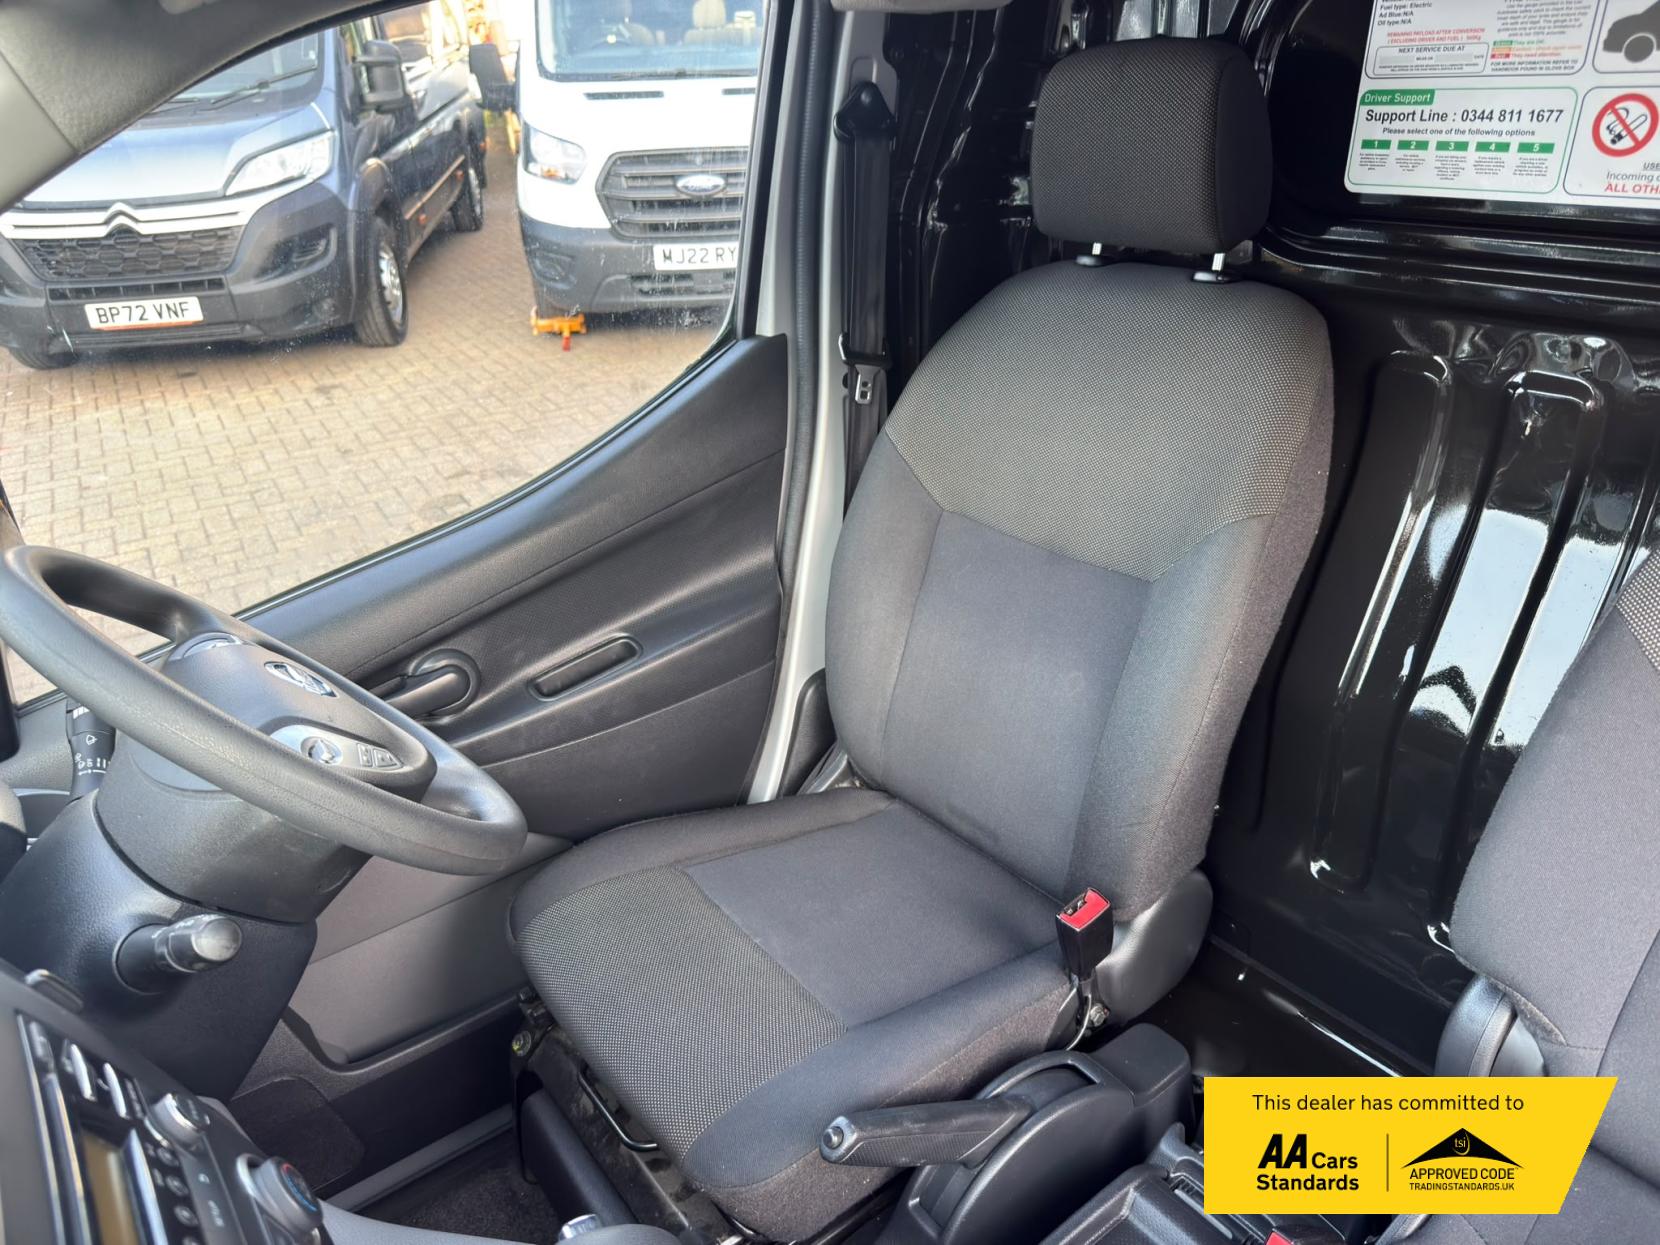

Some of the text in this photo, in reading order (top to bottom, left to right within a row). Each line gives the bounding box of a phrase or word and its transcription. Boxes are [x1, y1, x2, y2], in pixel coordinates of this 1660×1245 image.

[1364, 93, 1430, 104] Driver Support
[1365, 109, 1416, 124] Support
[1419, 109, 1448, 122] Line
[1461, 109, 1494, 122] 0344
[1498, 109, 1522, 122] 811
[1529, 109, 1564, 123] 1677
[1407, 127, 1428, 135] select
[1468, 128, 1503, 137] following
[1410, 141, 1416, 149] 2
[1448, 142, 1455, 150] 3
[1489, 143, 1496, 151] 4
[1532, 144, 1540, 152] 5
[1607, 171, 1654, 183] Incoming
[1604, 183, 1628, 193] ALL
[95, 301, 189, 324] BP72 VNF
